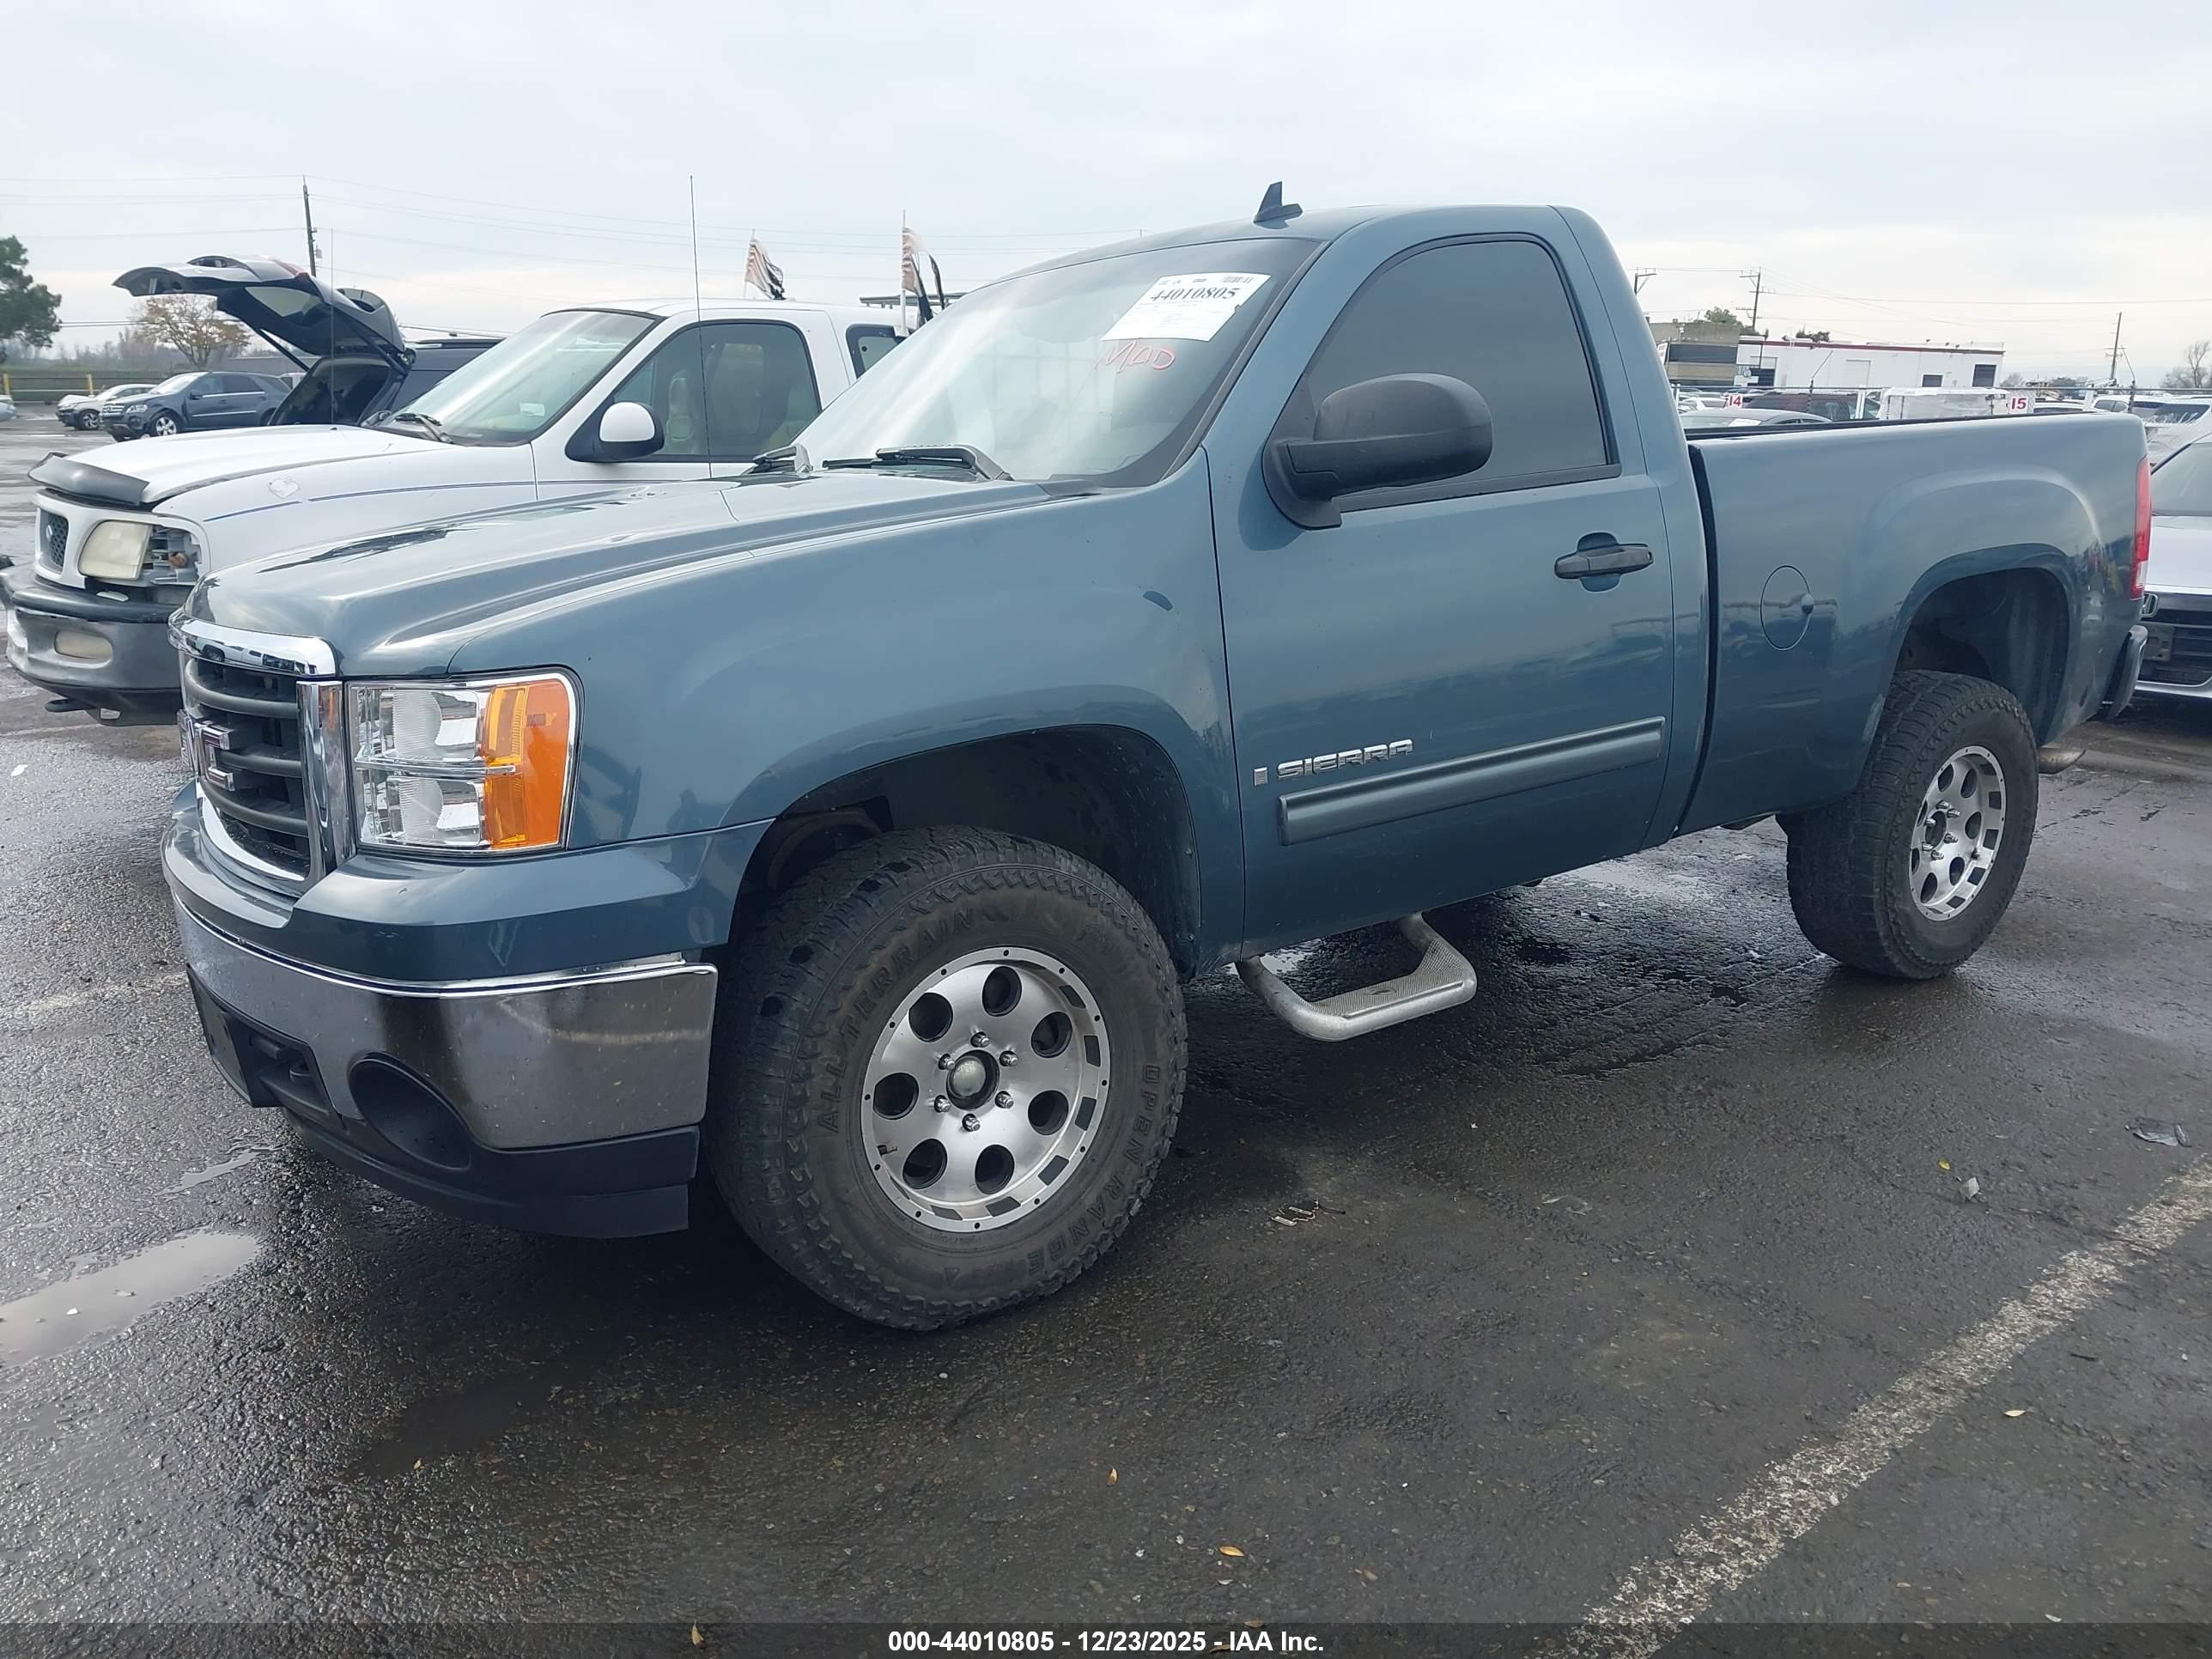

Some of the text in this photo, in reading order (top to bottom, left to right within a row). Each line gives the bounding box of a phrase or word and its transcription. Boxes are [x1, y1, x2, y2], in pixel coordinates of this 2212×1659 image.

[1151, 287, 1240, 301] 44010805
[1729, 395, 1741, 406] 14
[2010, 398, 2027, 410] 15
[1277, 738, 1413, 781] SIERRA
[817, 911, 972, 1133] ALL TERRAIN
[1028, 1064, 1159, 1273] OPEN RANGE
